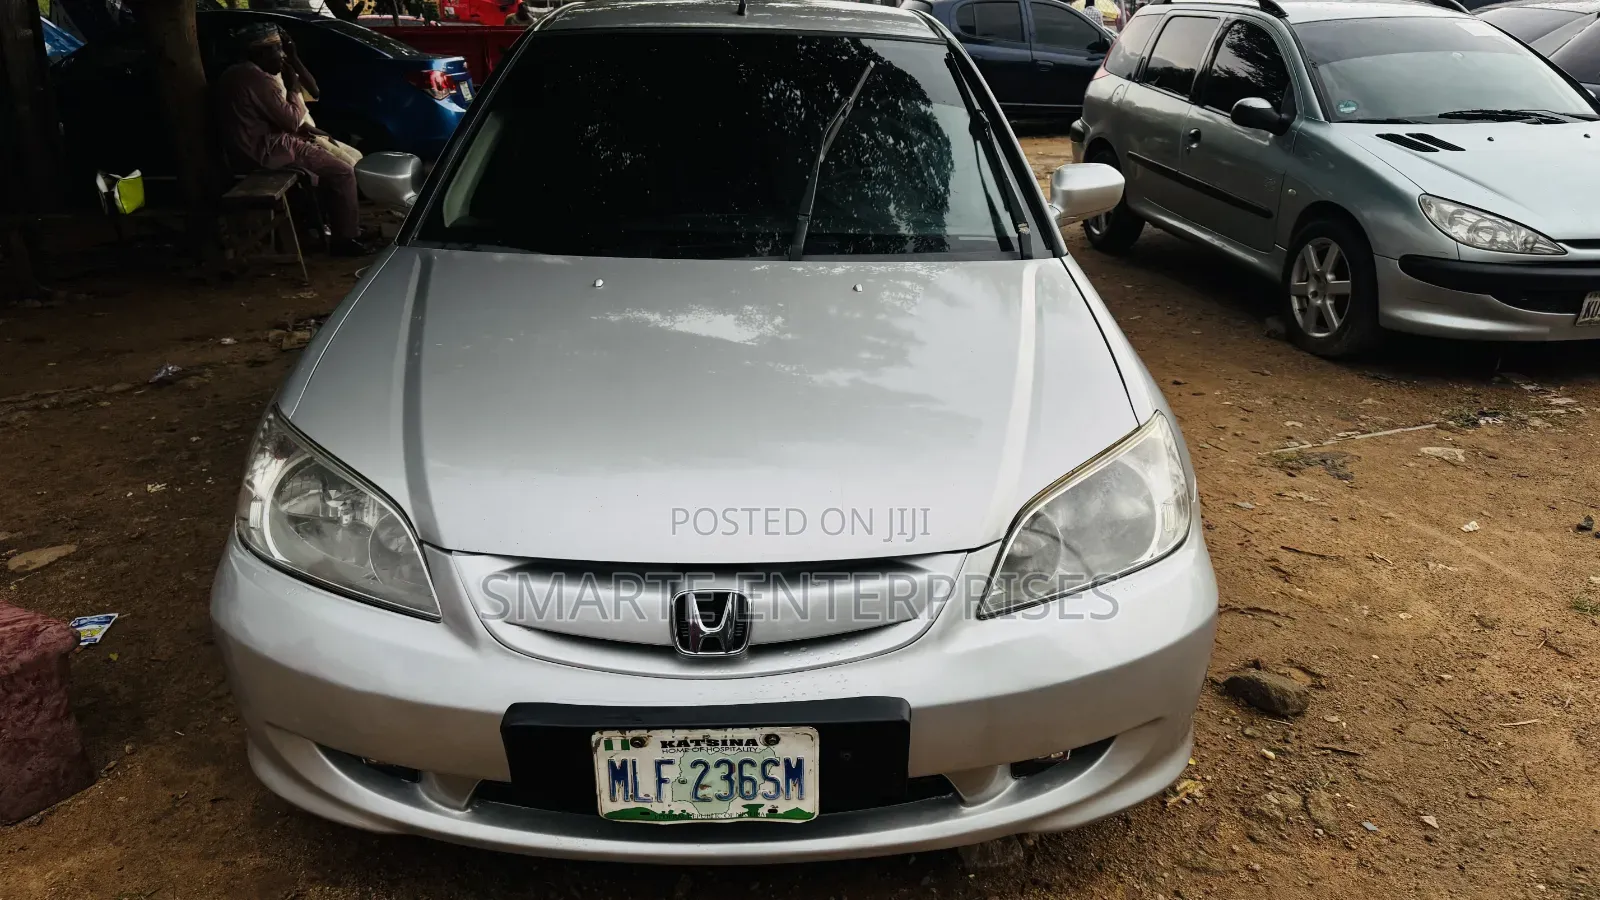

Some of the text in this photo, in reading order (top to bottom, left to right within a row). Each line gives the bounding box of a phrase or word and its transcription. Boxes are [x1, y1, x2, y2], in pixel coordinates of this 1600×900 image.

[660, 739, 759, 749] KATSINA
[607, 756, 805, 803] MLF 236SM
